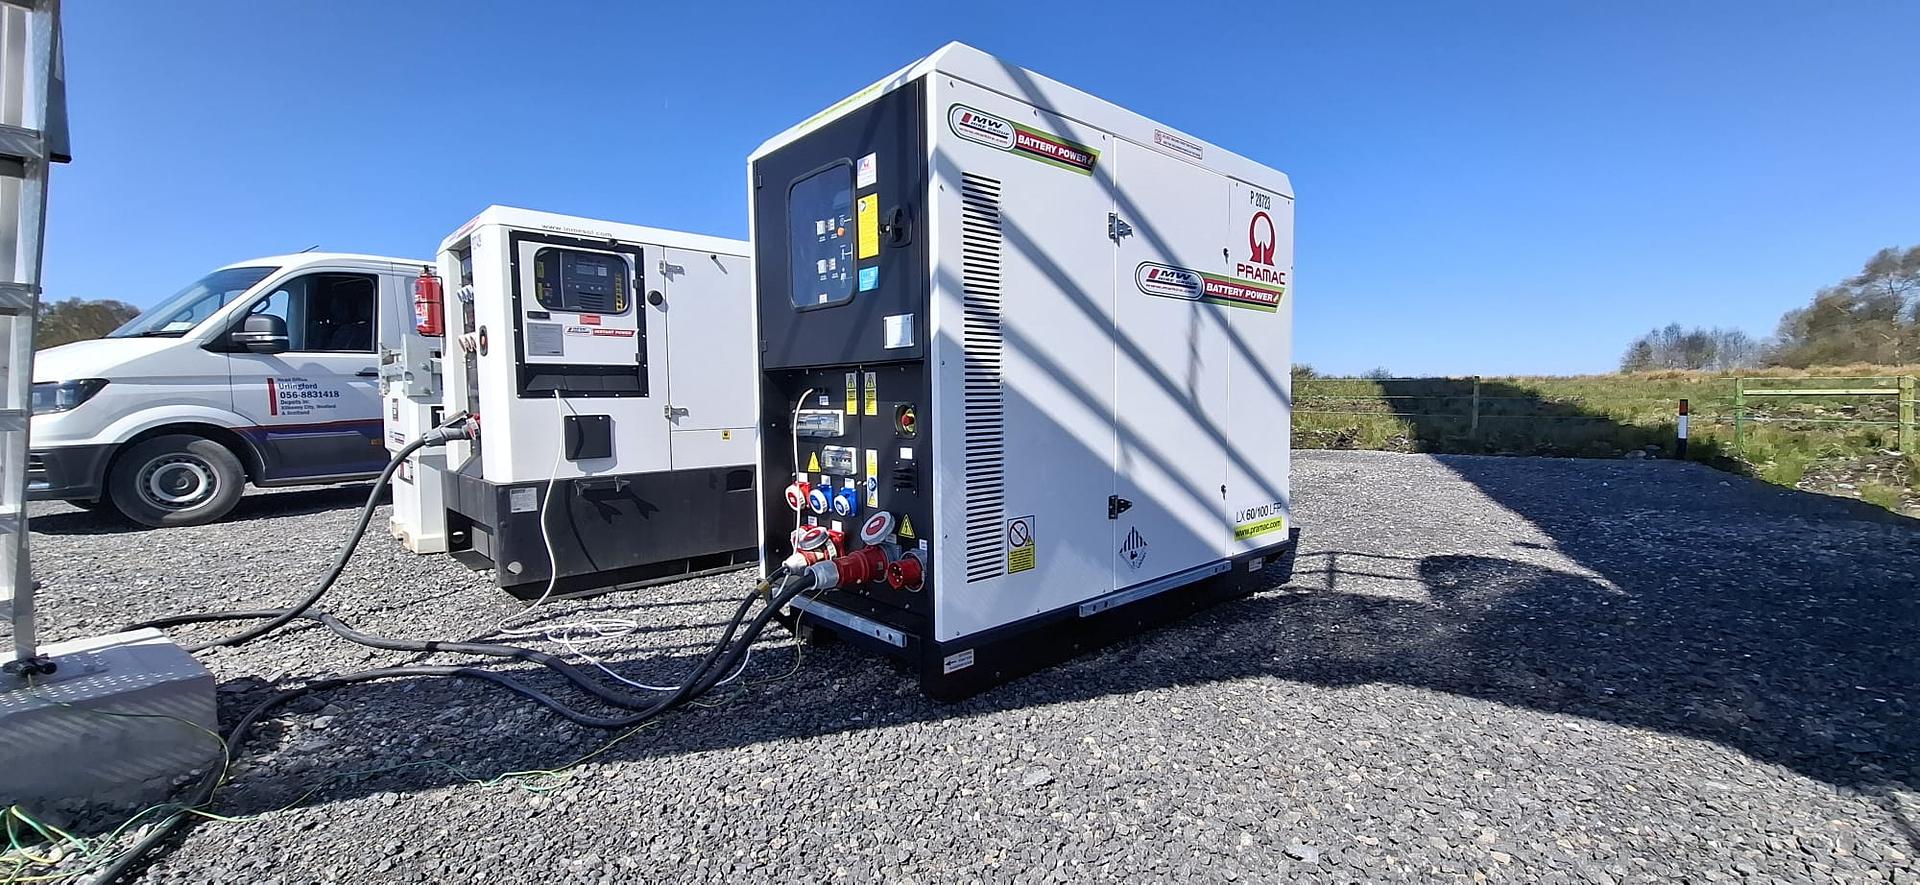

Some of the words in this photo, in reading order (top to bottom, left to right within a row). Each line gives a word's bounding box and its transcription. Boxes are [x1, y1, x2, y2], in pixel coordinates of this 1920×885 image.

[973, 115, 1002, 128] MW
[1017, 134, 1057, 154] BATTERY
[1058, 146, 1087, 163] POWER
[1250, 190, 1254, 205] P
[1160, 270, 1190, 280] MW
[1236, 263, 1286, 285] PRAMAC
[1206, 283, 1244, 296] BATTERY
[1245, 290, 1273, 302] POWER
[280, 391, 340, 399] 056-8831418
[1236, 510, 1245, 523] LX
[1246, 505, 1268, 520] 60/100
[1235, 520, 1280, 537] www.pramac.com
